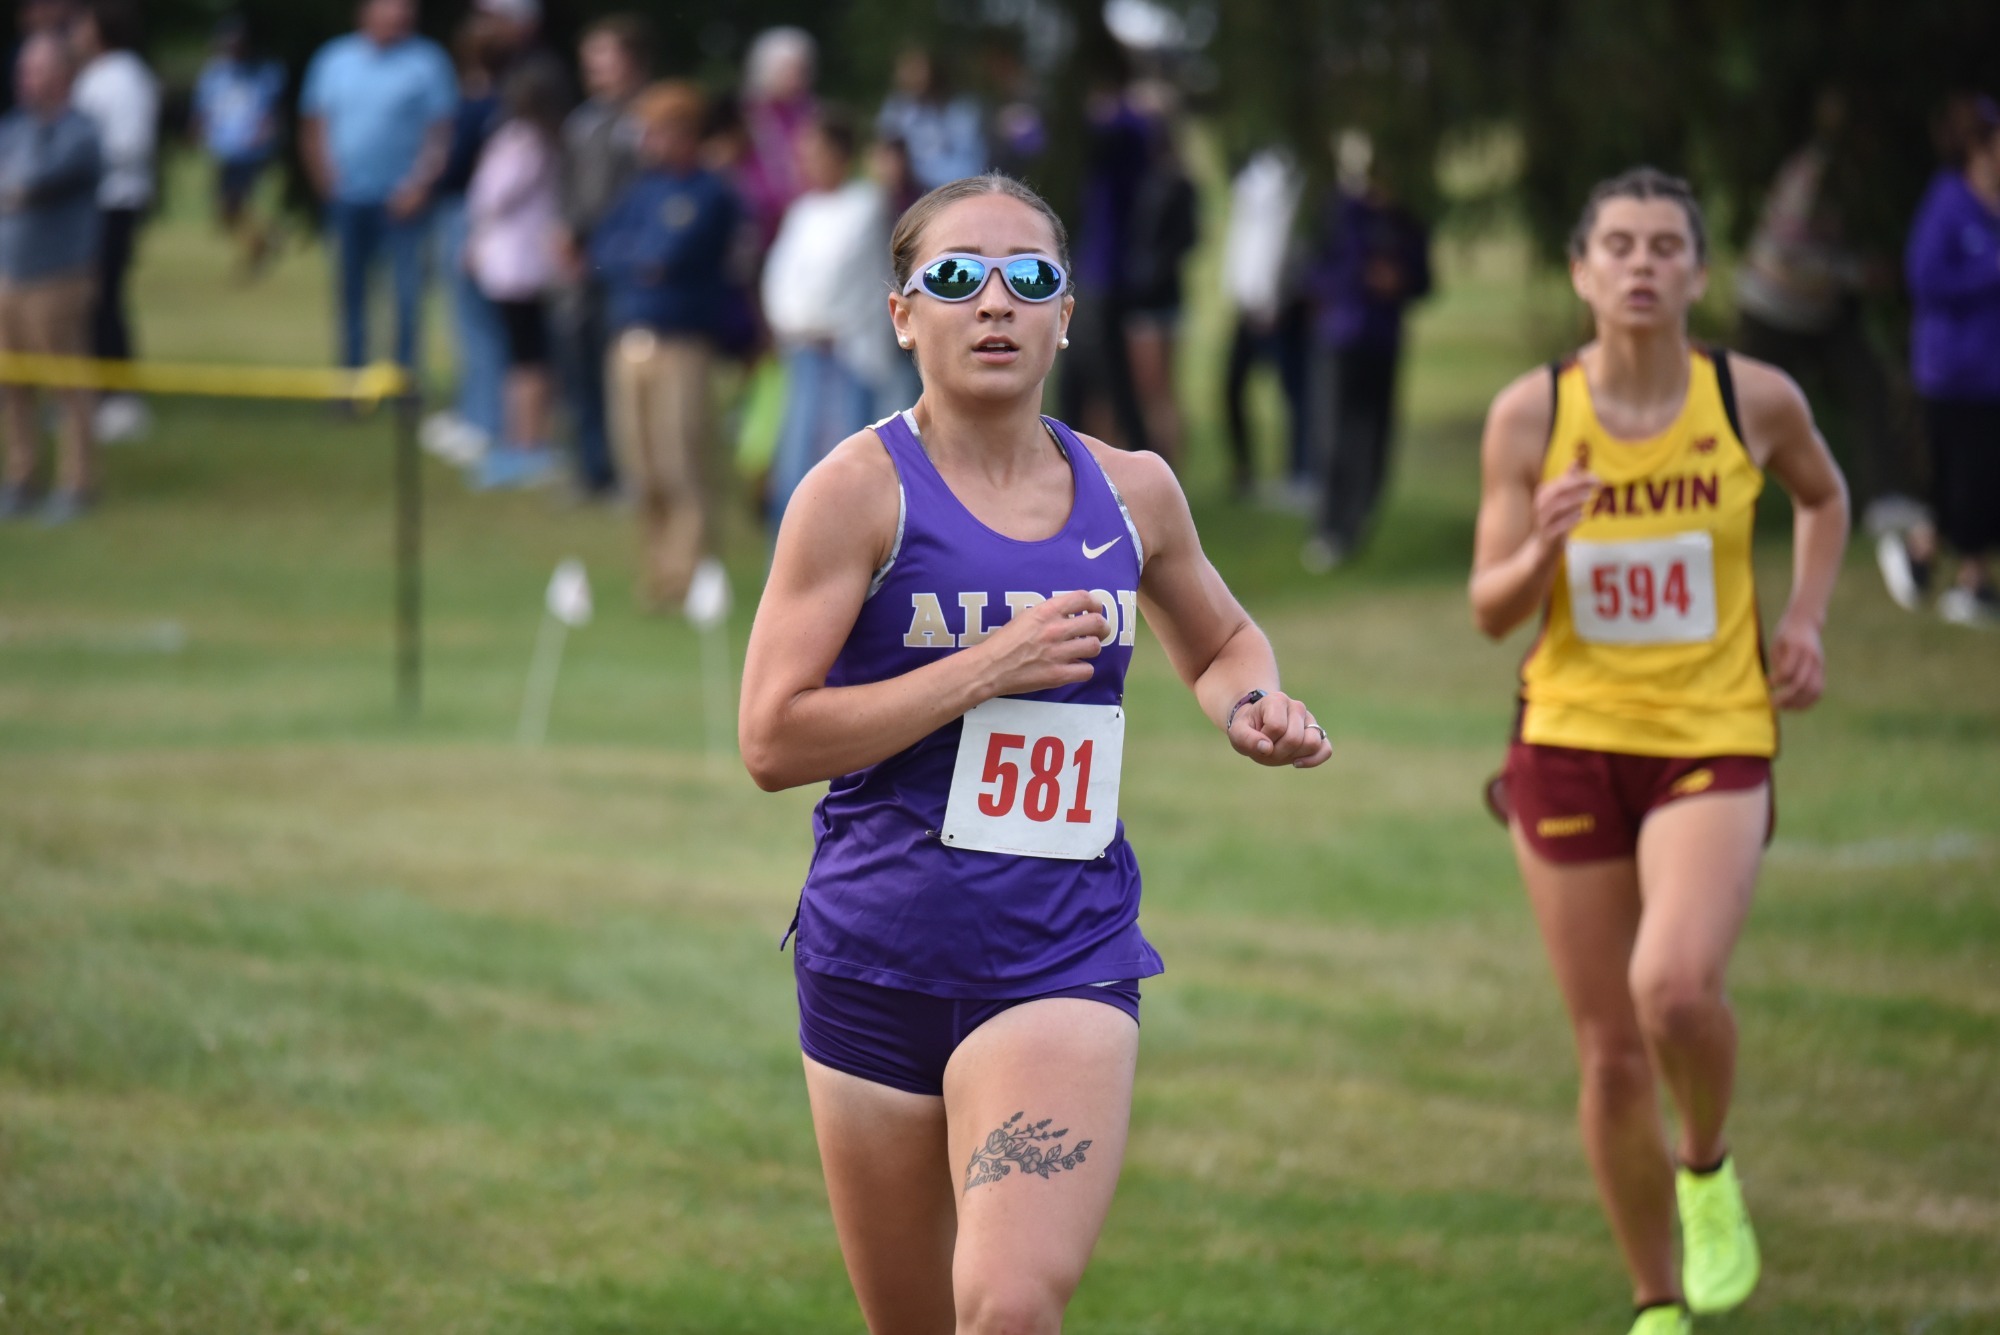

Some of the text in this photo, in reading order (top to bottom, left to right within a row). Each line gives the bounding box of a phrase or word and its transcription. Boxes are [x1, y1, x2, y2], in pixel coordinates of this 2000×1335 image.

[1590, 473, 1719, 516] ALVIN
[1591, 559, 1691, 622] 594
[977, 732, 1093, 823] 581
